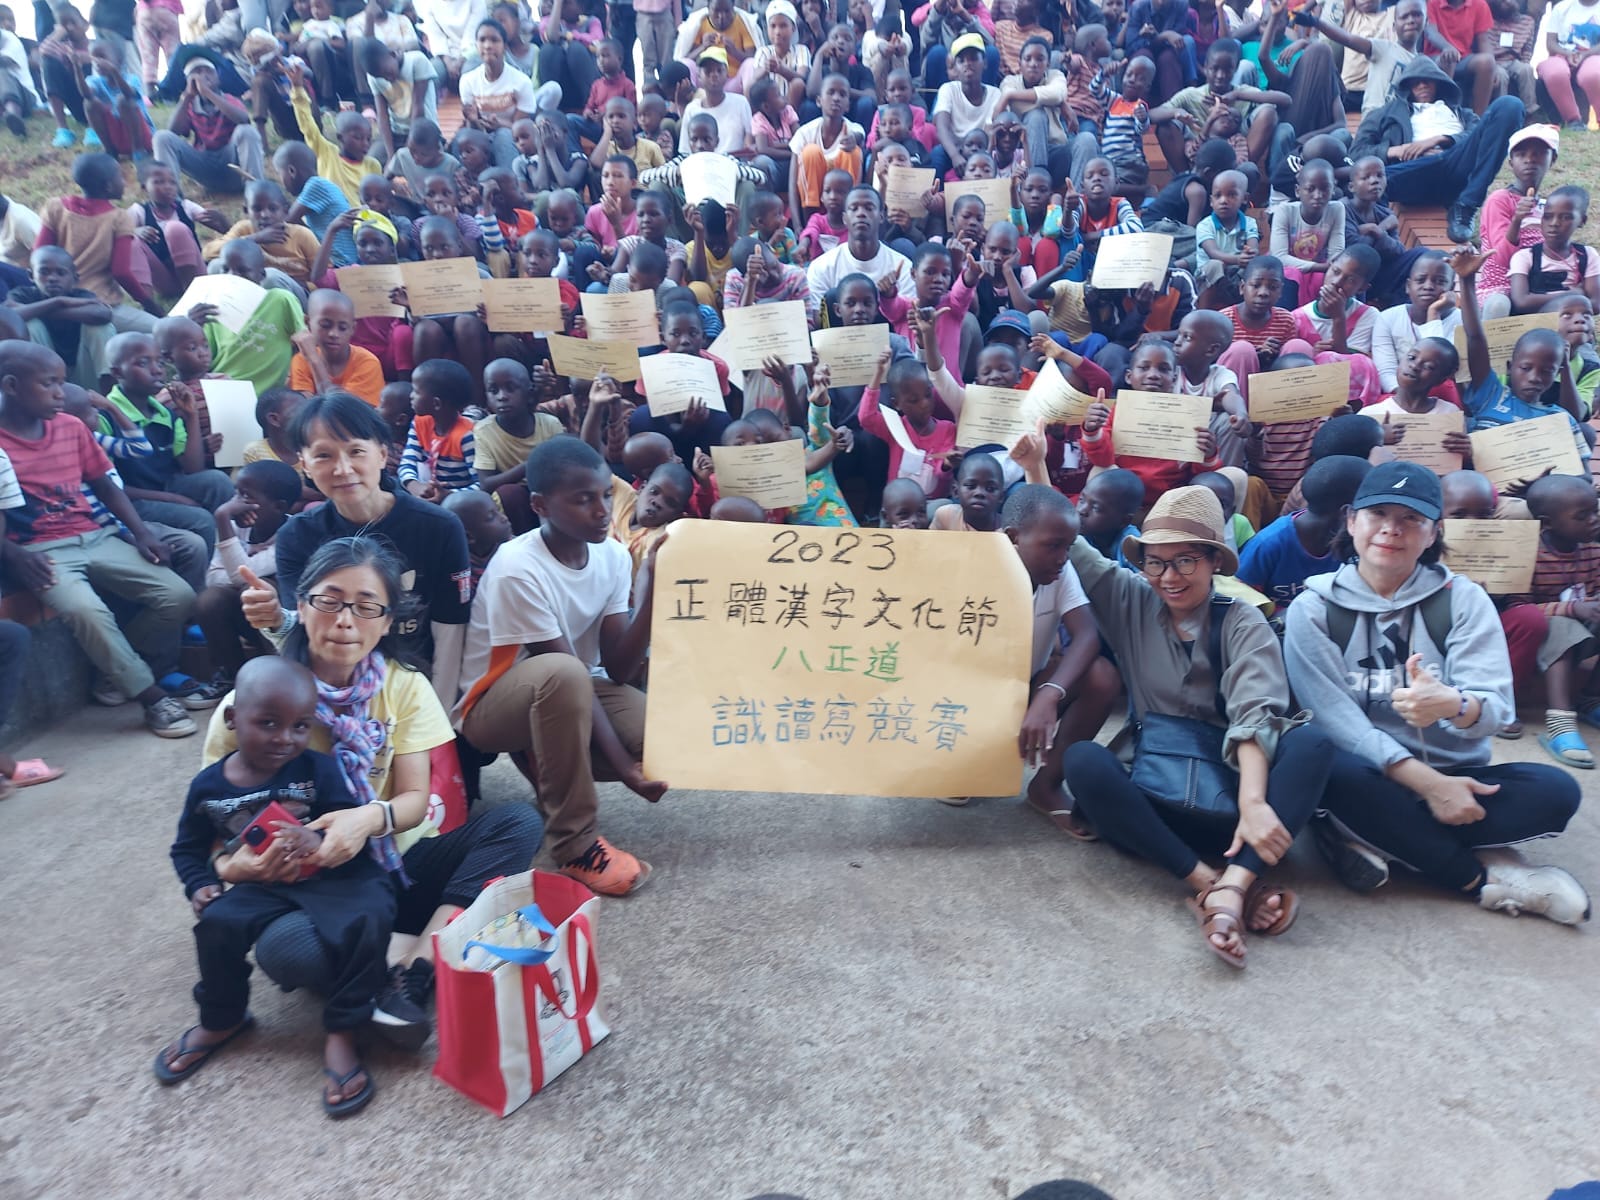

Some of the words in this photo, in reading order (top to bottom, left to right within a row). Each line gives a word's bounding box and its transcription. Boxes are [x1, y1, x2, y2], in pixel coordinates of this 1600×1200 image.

[768, 530, 896, 570] 2023
[667, 579, 999, 646] 正體漢字文化節
[772, 642, 904, 682] 八正道
